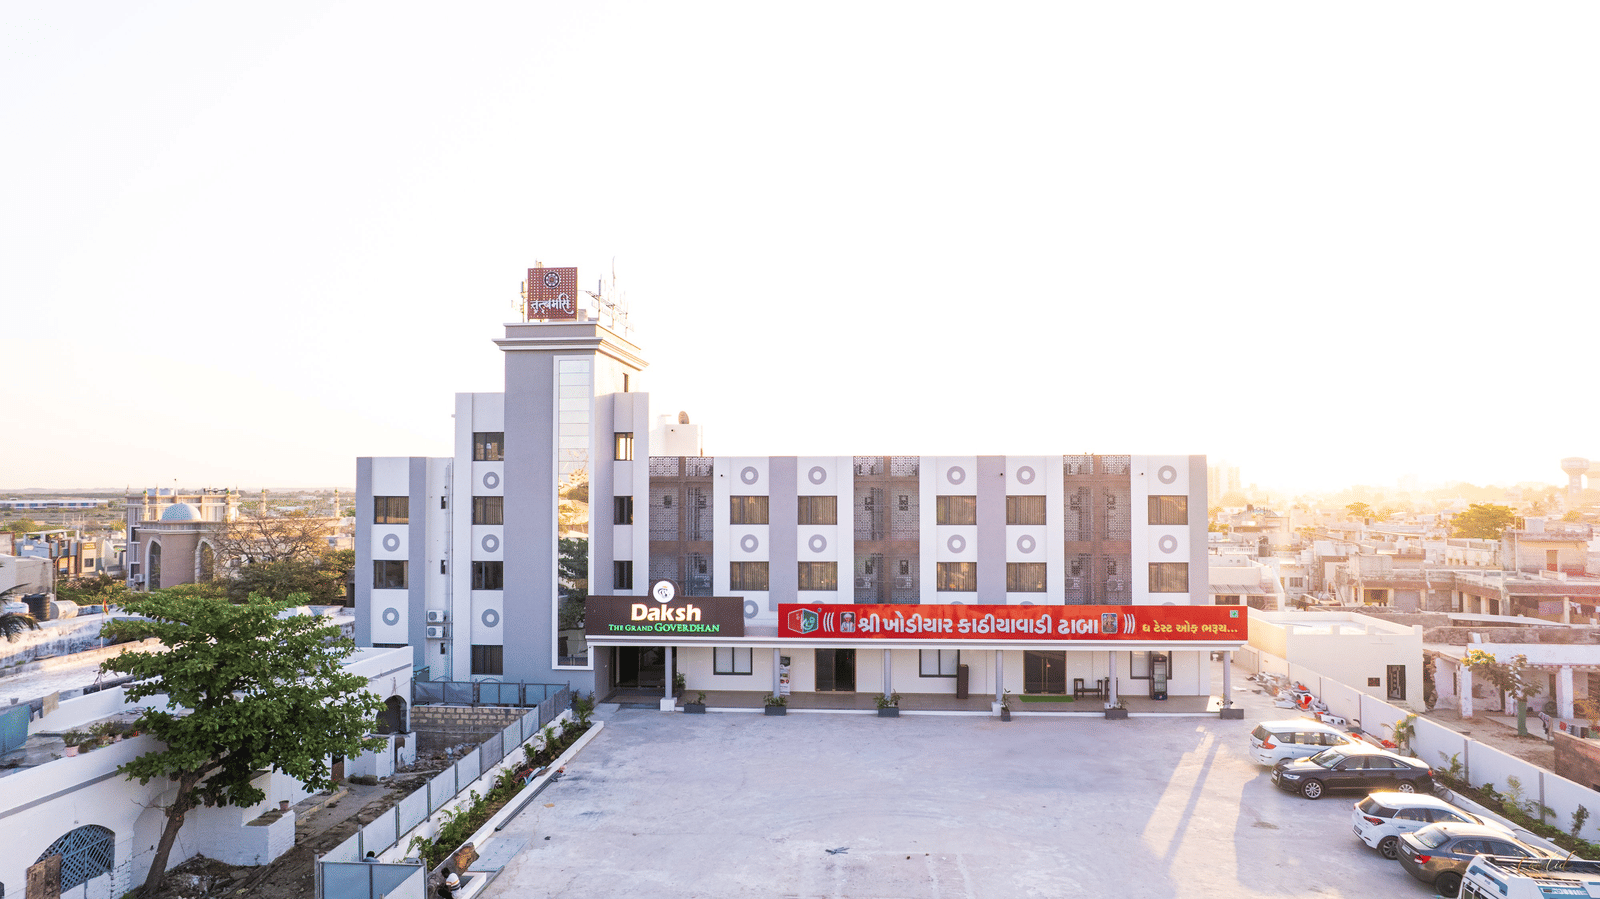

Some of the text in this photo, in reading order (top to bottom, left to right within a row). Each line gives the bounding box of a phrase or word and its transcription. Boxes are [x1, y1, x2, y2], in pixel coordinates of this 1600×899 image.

[631, 603, 701, 622] Daksh
[654, 622, 720, 633] GOVERDHAN
[858, 611, 1098, 634] શ્રી ખોડીયાર કાઠીયાવાડી ઢાબા
